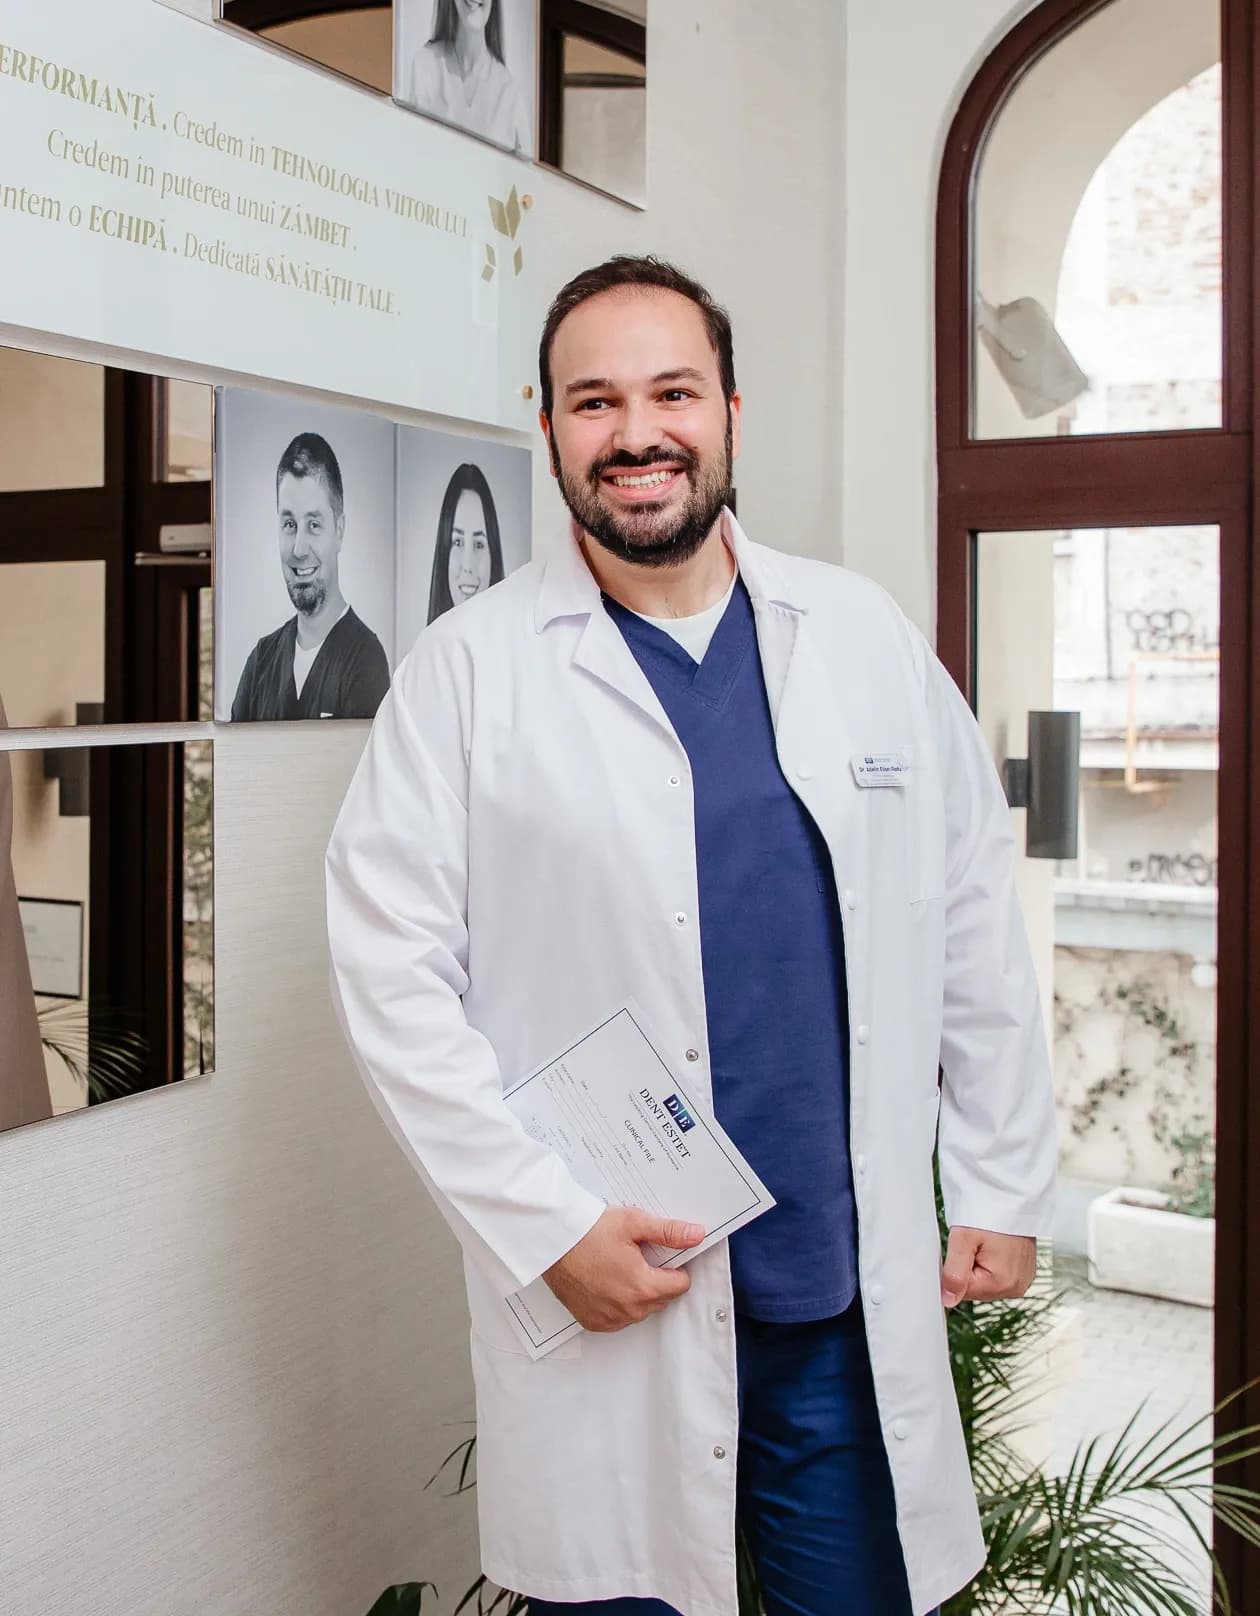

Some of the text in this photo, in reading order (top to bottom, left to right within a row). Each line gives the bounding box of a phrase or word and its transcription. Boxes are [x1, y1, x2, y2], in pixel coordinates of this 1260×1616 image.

[47, 129, 130, 179] Credem
[136, 156, 155, 188] în
[160, 171, 231, 210] puterea
[237, 195, 275, 225] unui
[173, 111, 243, 158] Credem
[271, 146, 379, 207] TEHNOLOGIA
[385, 188, 468, 238] VIITORULUI
[0, 184, 61, 221] ntem
[69, 205, 82, 227] o
[88, 204, 167, 252] ECHIPĂ
[183, 232, 260, 278] Dedicată
[356, 282, 396, 314] TALE
[624, 1119, 647, 1149] CLINICAL
[642, 1148, 656, 1163] FILE
[639, 1088, 691, 1158] DENT ESTET
